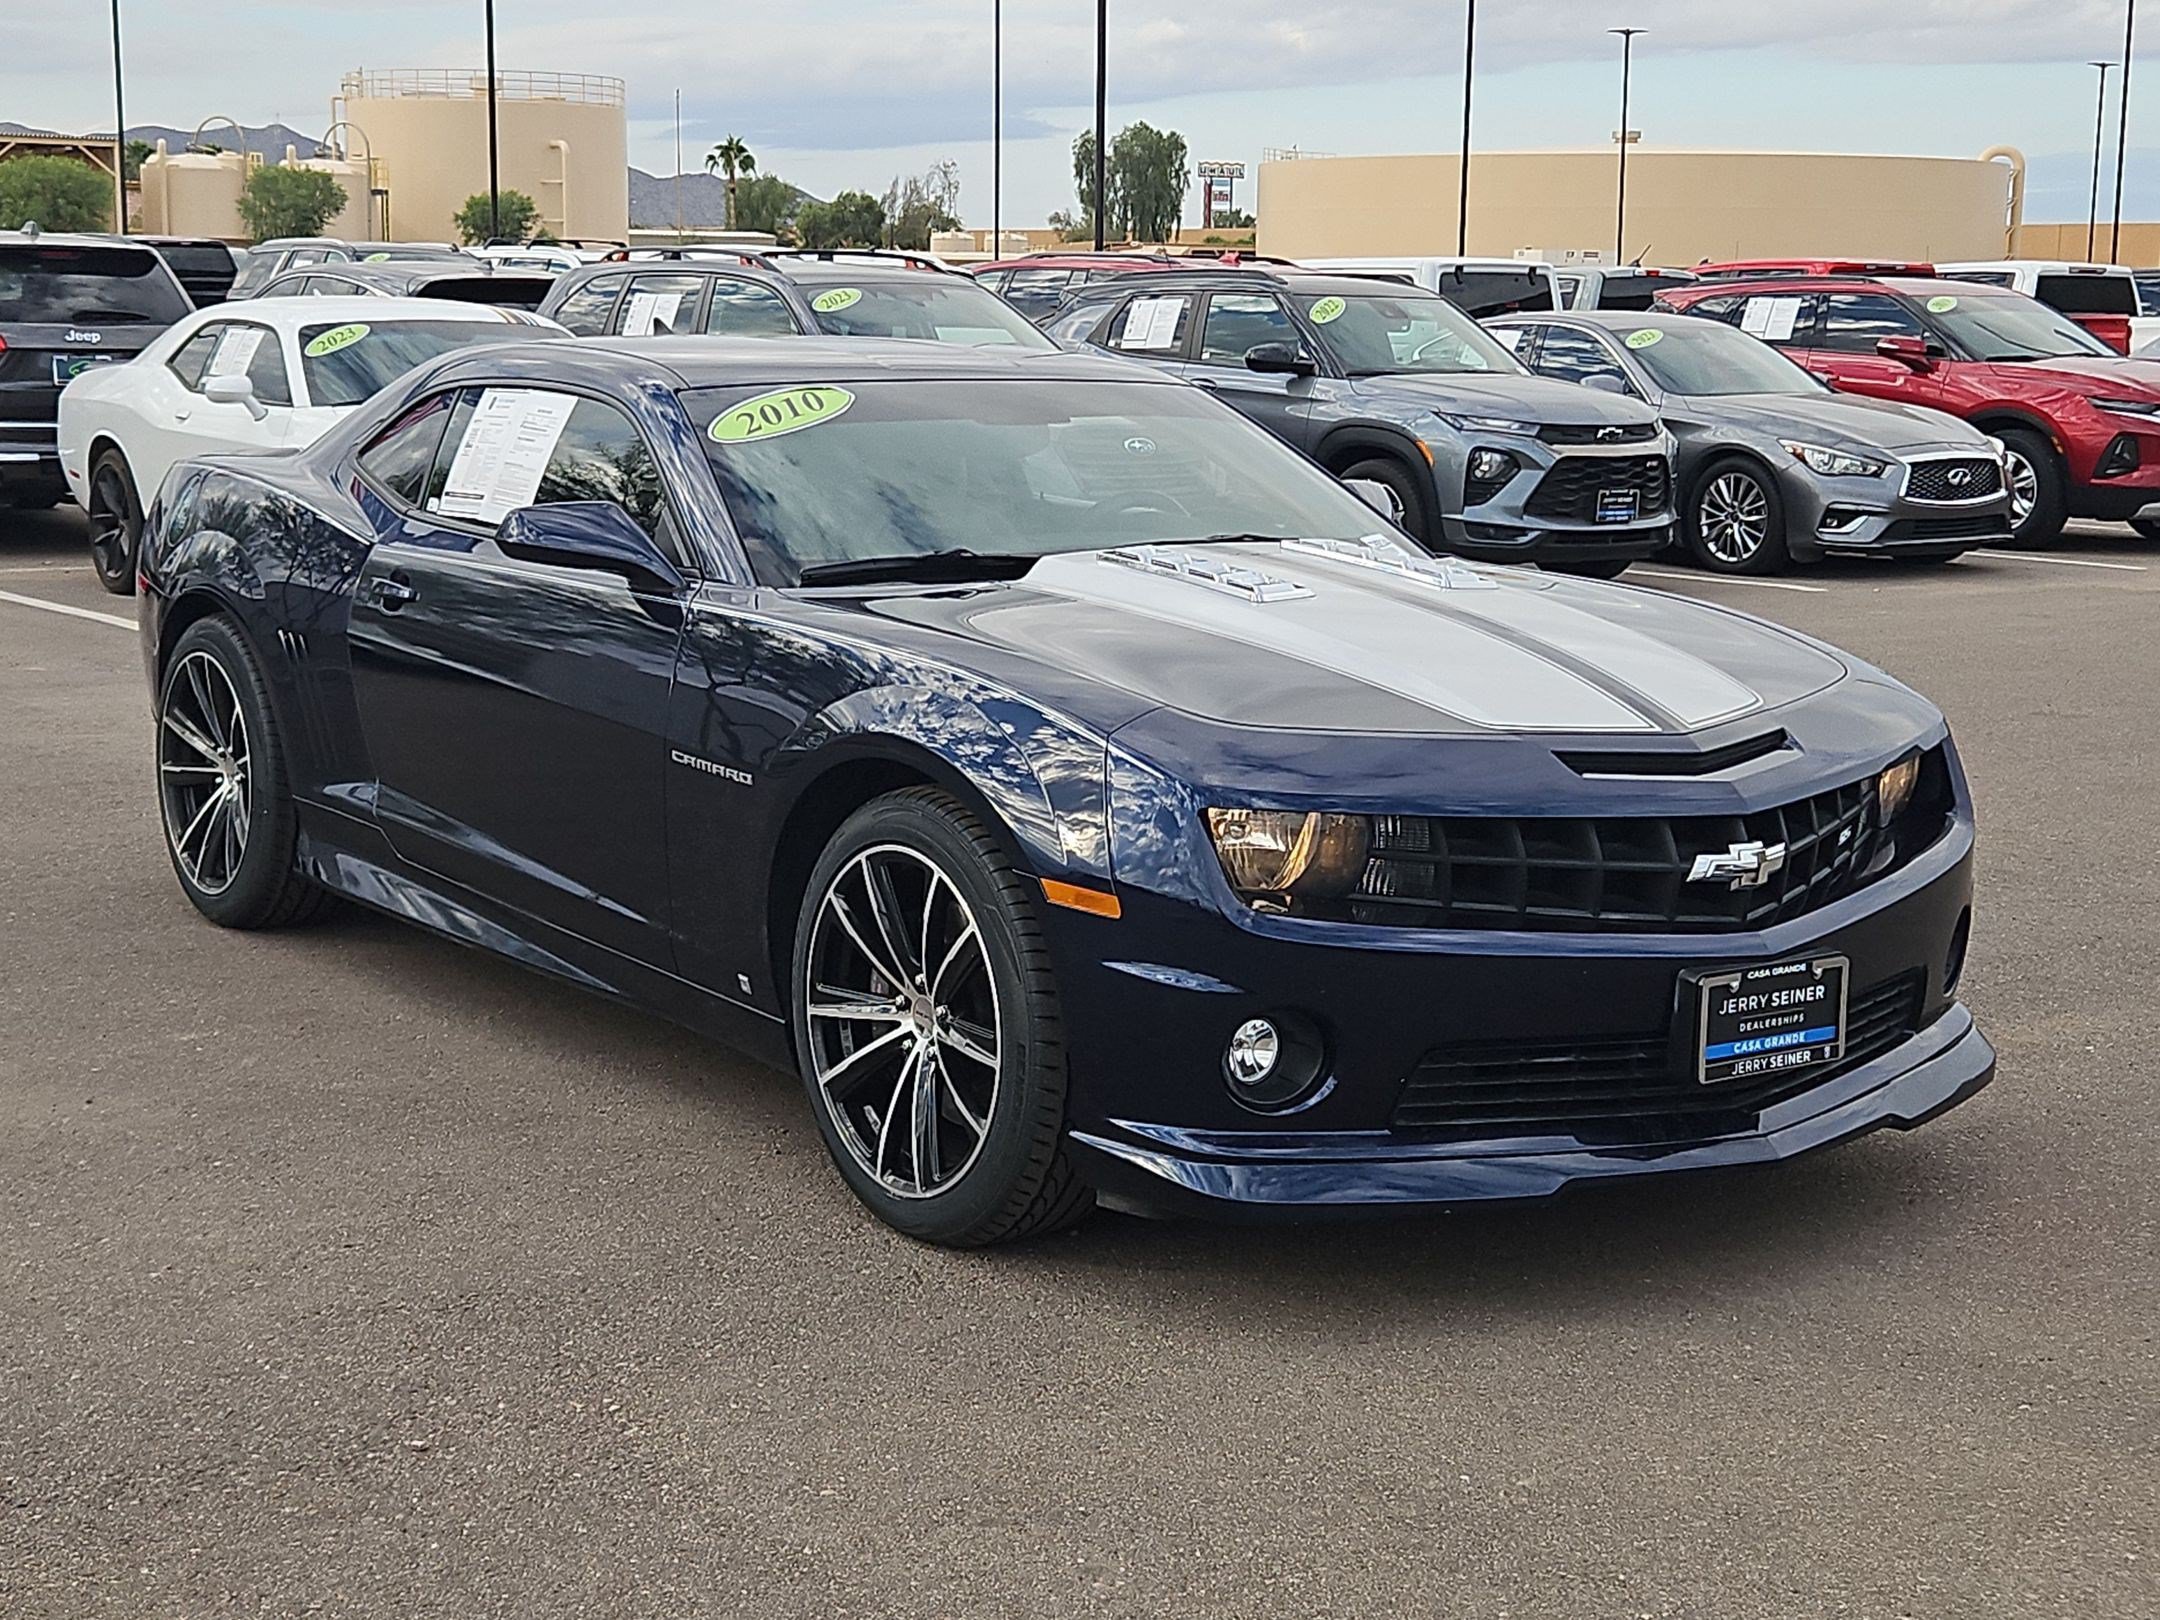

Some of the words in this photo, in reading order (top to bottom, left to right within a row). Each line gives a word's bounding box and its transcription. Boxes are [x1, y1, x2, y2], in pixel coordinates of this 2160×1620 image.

[821, 290, 852, 309] 2023
[1315, 299, 1339, 320] 2022
[64, 329, 101, 344] Jeep
[317, 327, 357, 352] 2023
[736, 391, 824, 435] 2010
[671, 749, 753, 786] CAMARO
[1747, 967, 1770, 979] CASA
[1772, 963, 1807, 976] GRANDE
[1719, 993, 1769, 1015] JERRY
[1771, 985, 1825, 1006] SEINER
[1739, 1012, 1805, 1032] DEALERSHIPS
[1734, 1040, 1761, 1053] CASA
[1764, 1031, 1806, 1049] GRANDE
[1731, 1058, 1770, 1075] JERRY
[1770, 1050, 1811, 1069] SEINER
